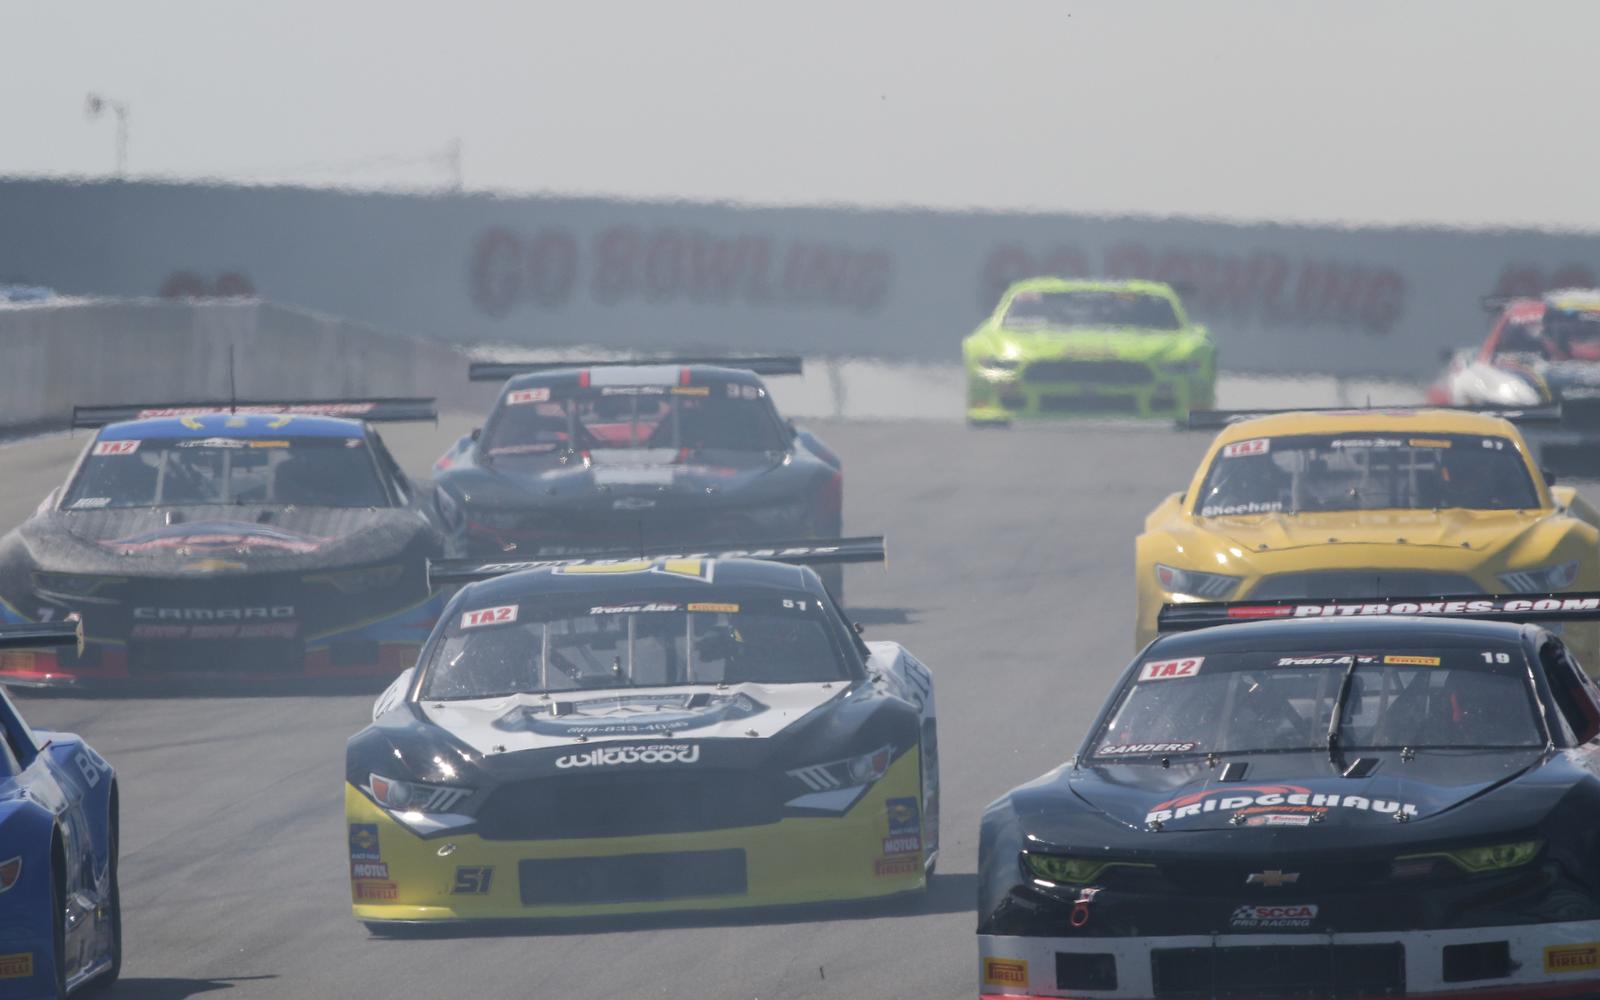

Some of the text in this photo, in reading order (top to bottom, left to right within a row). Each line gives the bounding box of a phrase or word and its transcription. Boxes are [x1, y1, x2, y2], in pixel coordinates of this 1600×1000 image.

[99, 440, 135, 454] TA2
[1294, 597, 1600, 617] PITBOXES.COM
[469, 608, 511, 624] TA2
[1481, 652, 1510, 664] 19
[1150, 660, 1192, 677] TA2
[1100, 743, 1194, 754] SANDERS
[555, 745, 700, 768] wilwood
[1145, 794, 1418, 823] BRIDGEHAUL
[884, 838, 920, 852] MOTUL
[354, 864, 388, 877] MOTUL
[1256, 908, 1313, 917] SCCA
[988, 962, 1025, 982] PIRELLI
